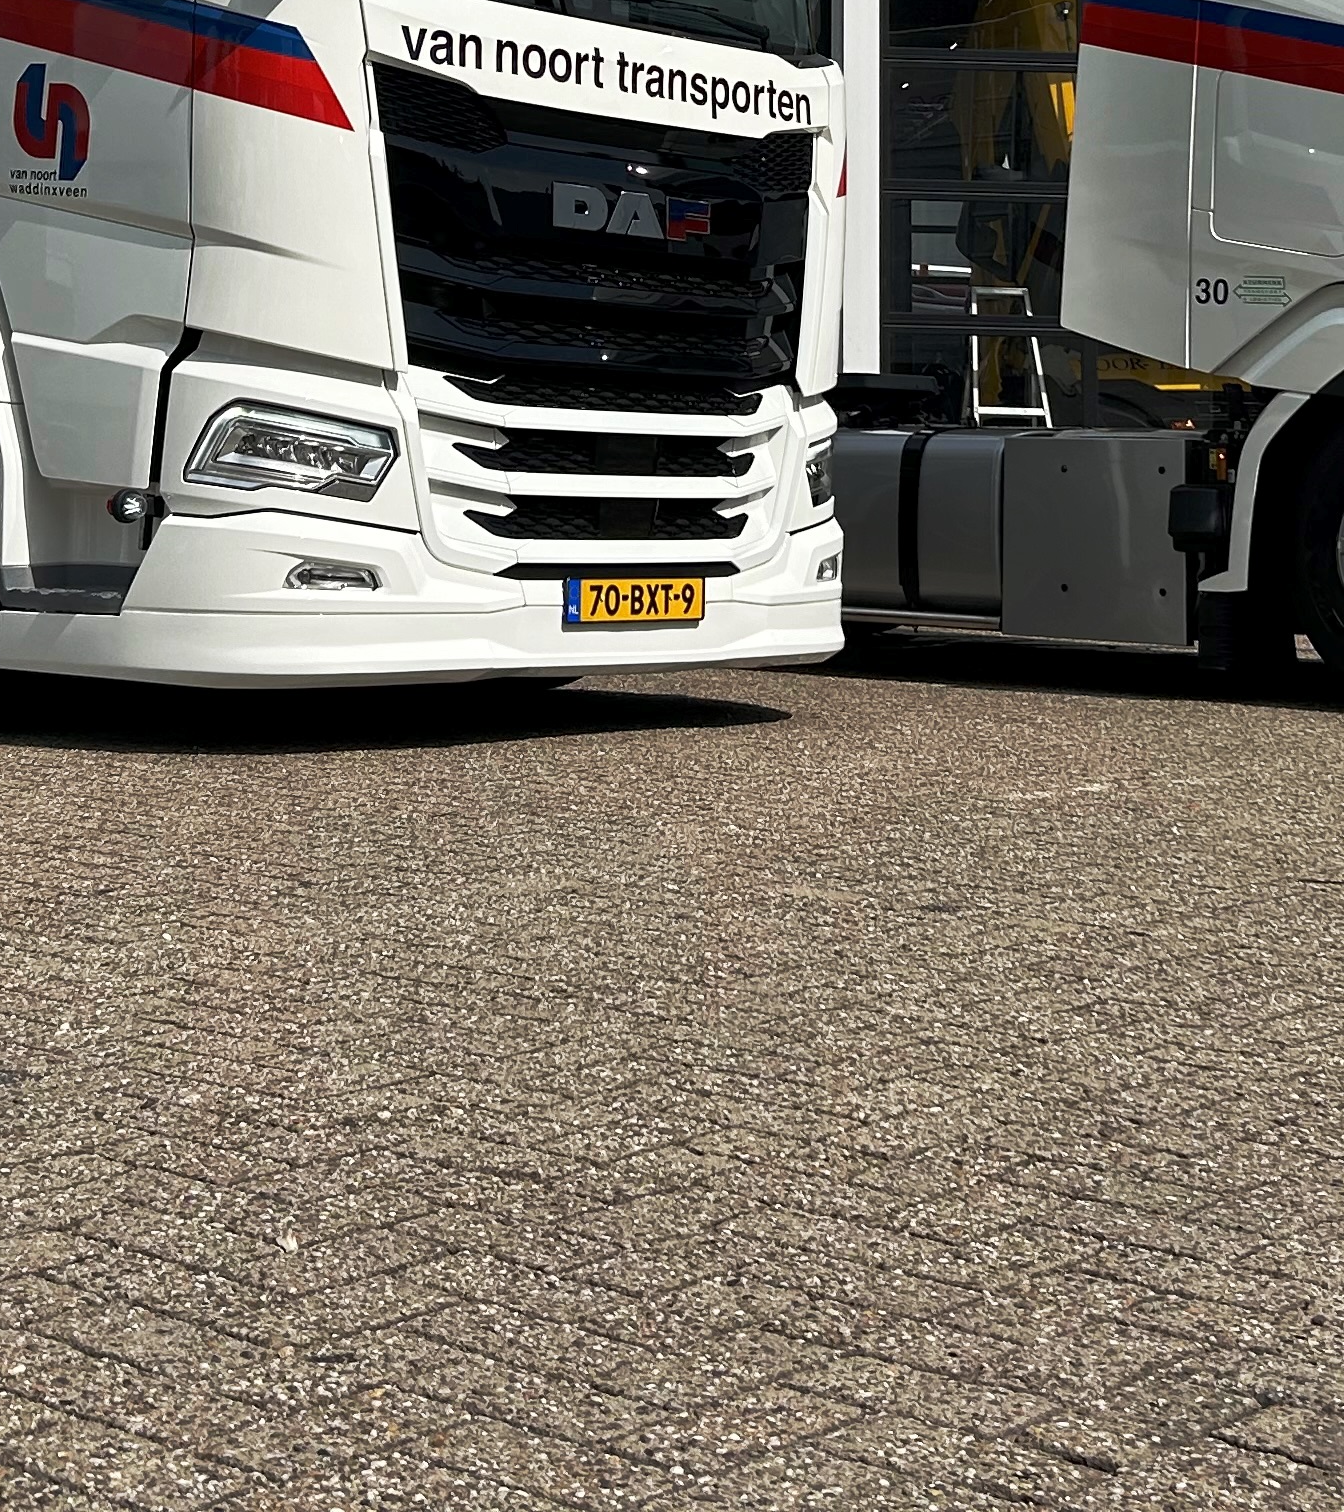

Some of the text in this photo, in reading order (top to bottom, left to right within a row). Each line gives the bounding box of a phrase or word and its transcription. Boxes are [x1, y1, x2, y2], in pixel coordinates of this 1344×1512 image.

[401, 24, 813, 126] van noort transporten
[9, 168, 57, 181] van noort
[9, 183, 88, 198] waddinxveen
[552, 181, 712, 242] DAF
[1195, 277, 1229, 305] 30
[568, 604, 579, 615] NL
[589, 583, 695, 617] 70-BXT-9
